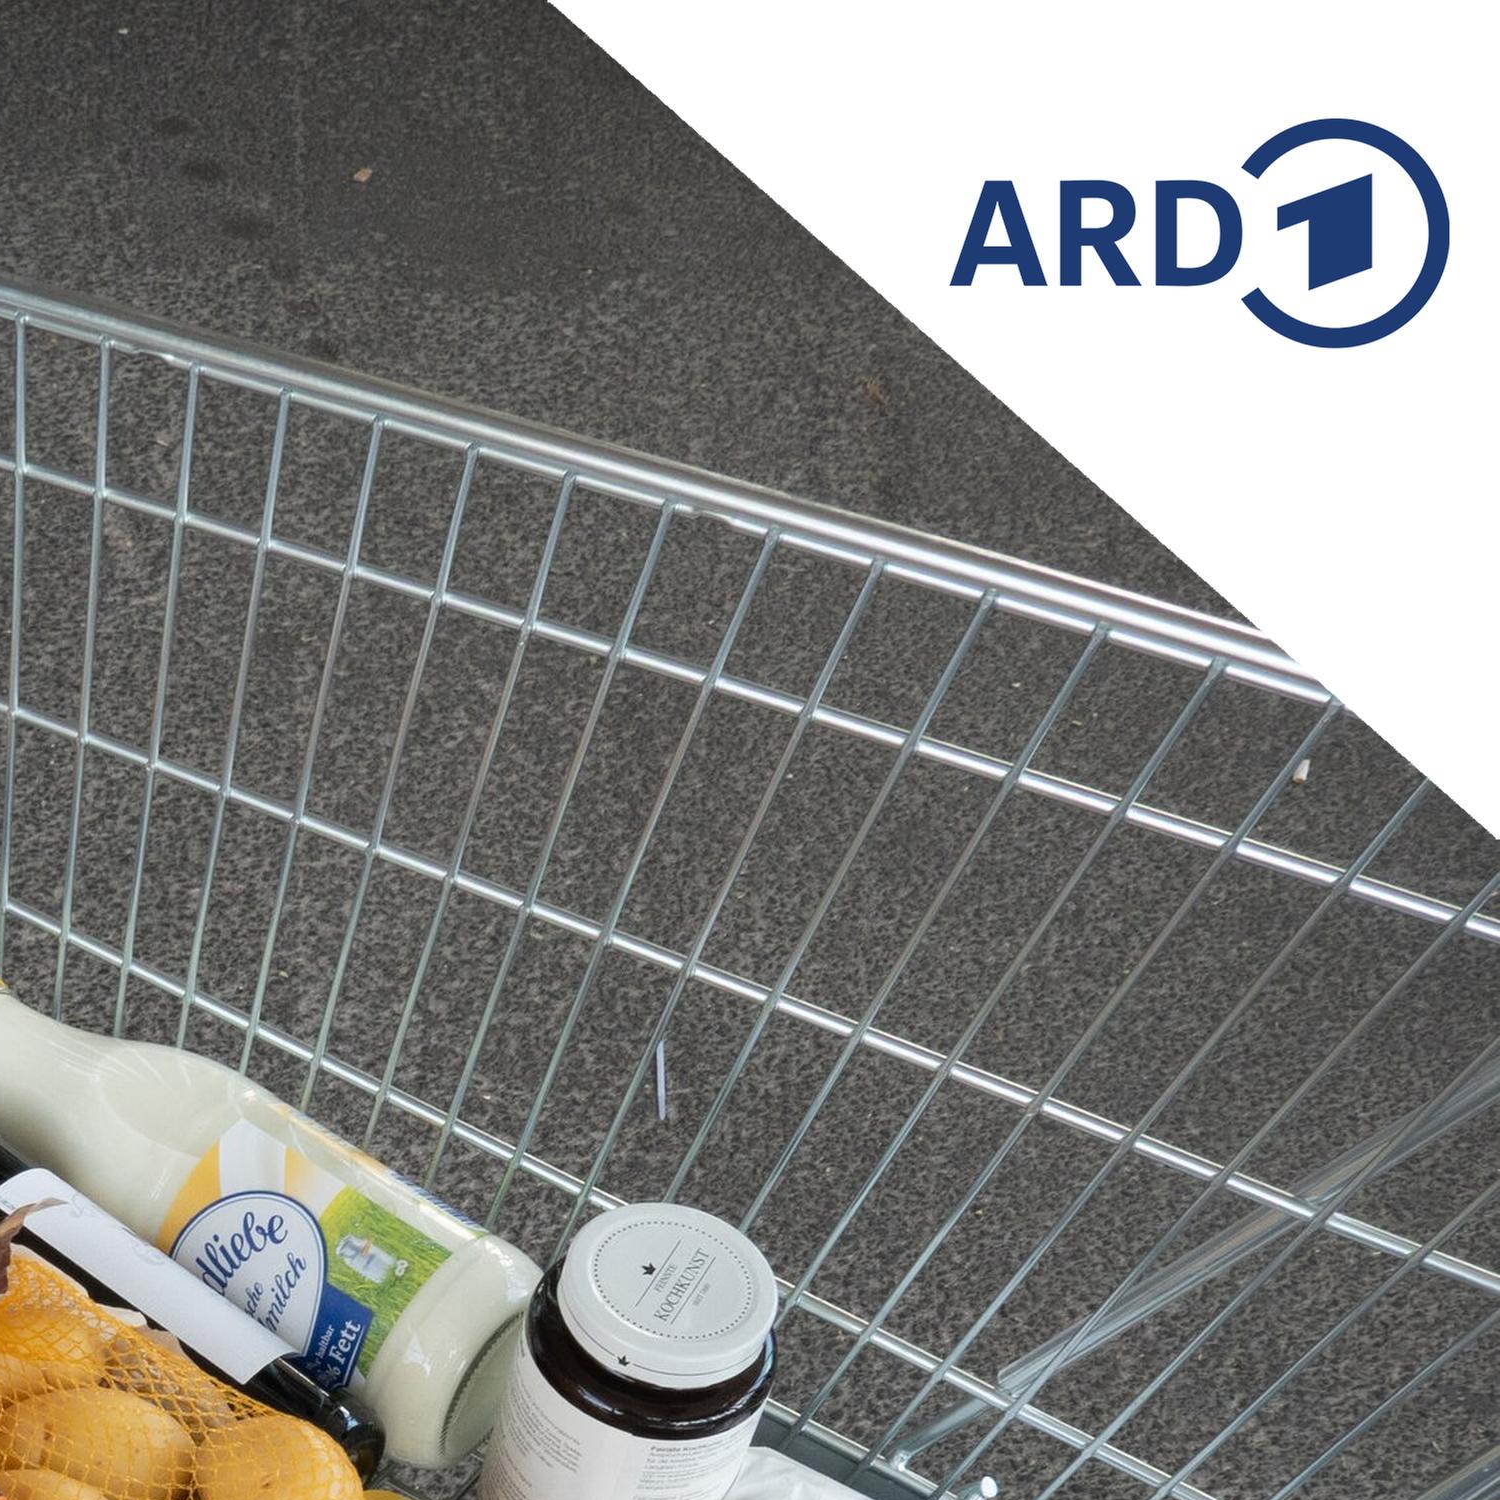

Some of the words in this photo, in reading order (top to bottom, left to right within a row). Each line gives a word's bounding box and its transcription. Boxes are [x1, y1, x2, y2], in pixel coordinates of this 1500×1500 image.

[653, 1263, 679, 1293] FEINSTE
[653, 1247, 710, 1323] KOCHKUNST
[244, 1280, 266, 1321] sche
[313, 1323, 338, 1360] haltbar
[328, 1317, 363, 1369] Fett
